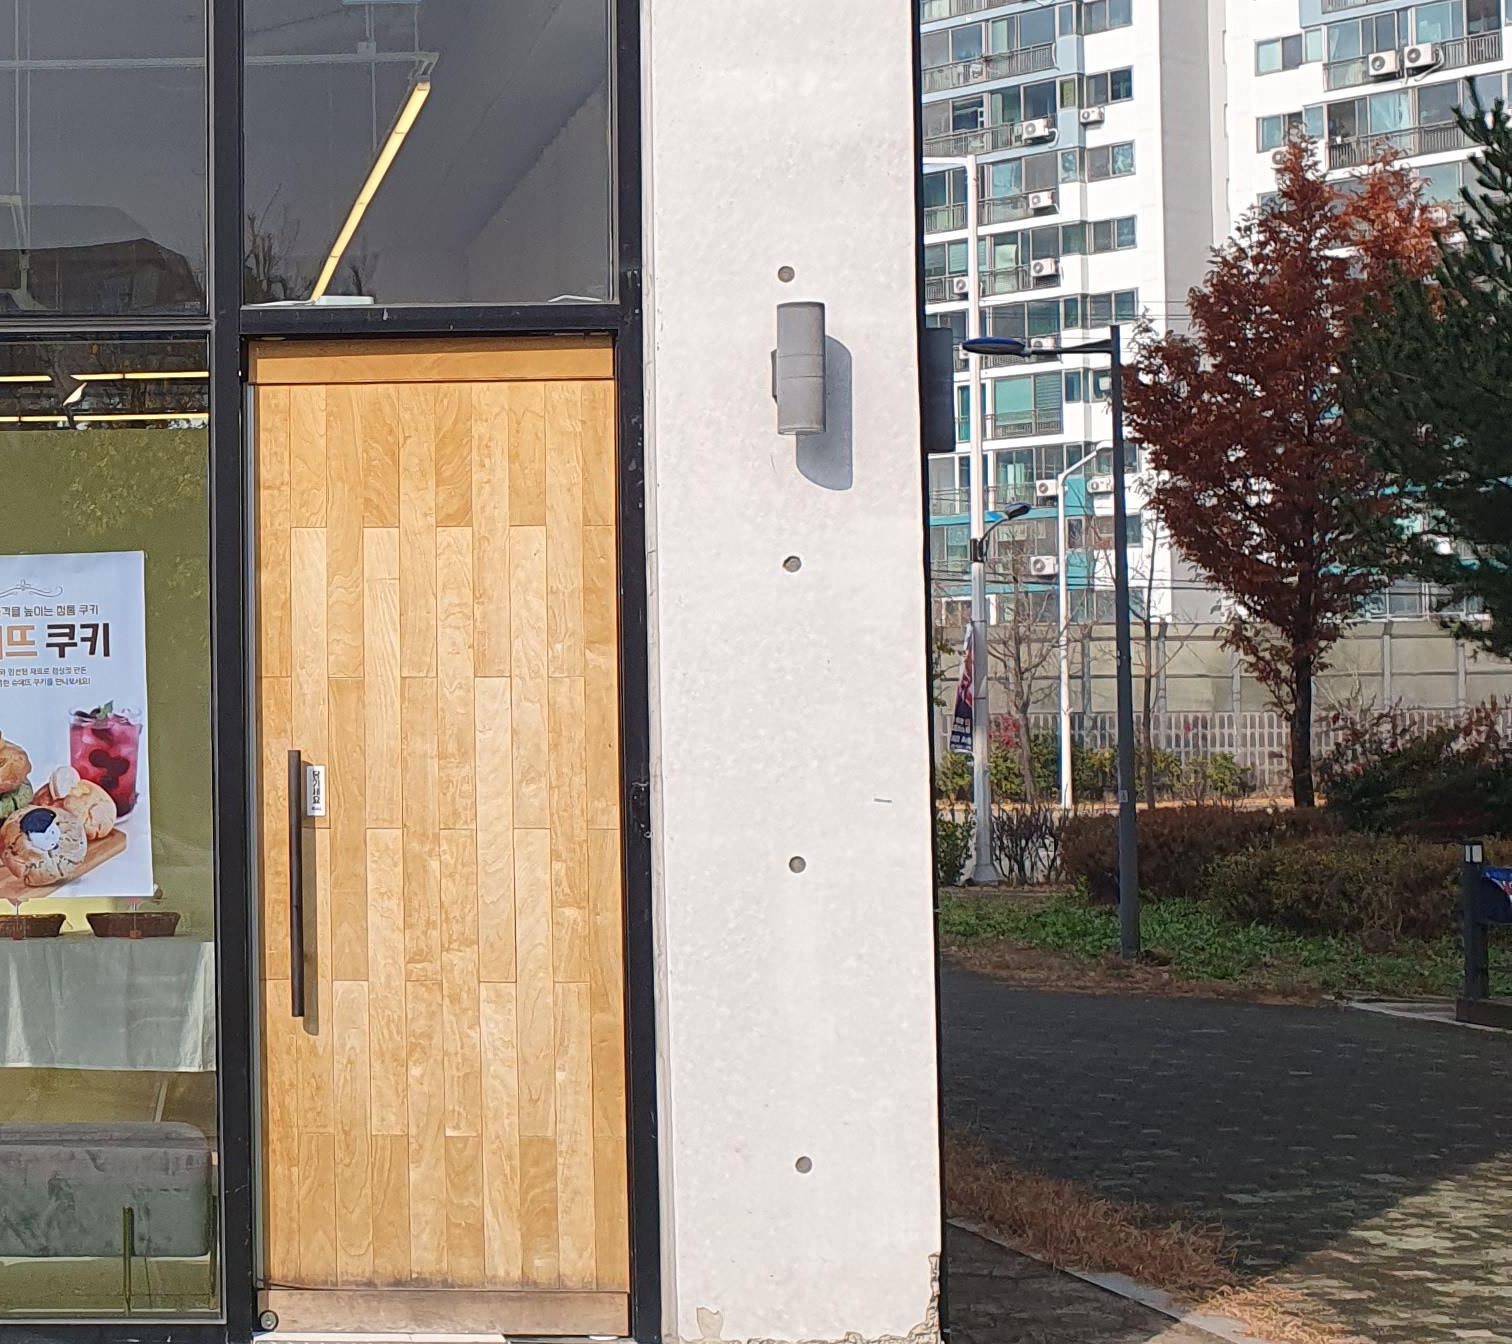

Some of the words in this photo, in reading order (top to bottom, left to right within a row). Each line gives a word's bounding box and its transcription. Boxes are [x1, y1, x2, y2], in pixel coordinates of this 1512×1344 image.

[24, 605, 53, 617] 높이는
[79, 604, 99, 616] 쿠키
[46, 622, 110, 659] 쿠키
